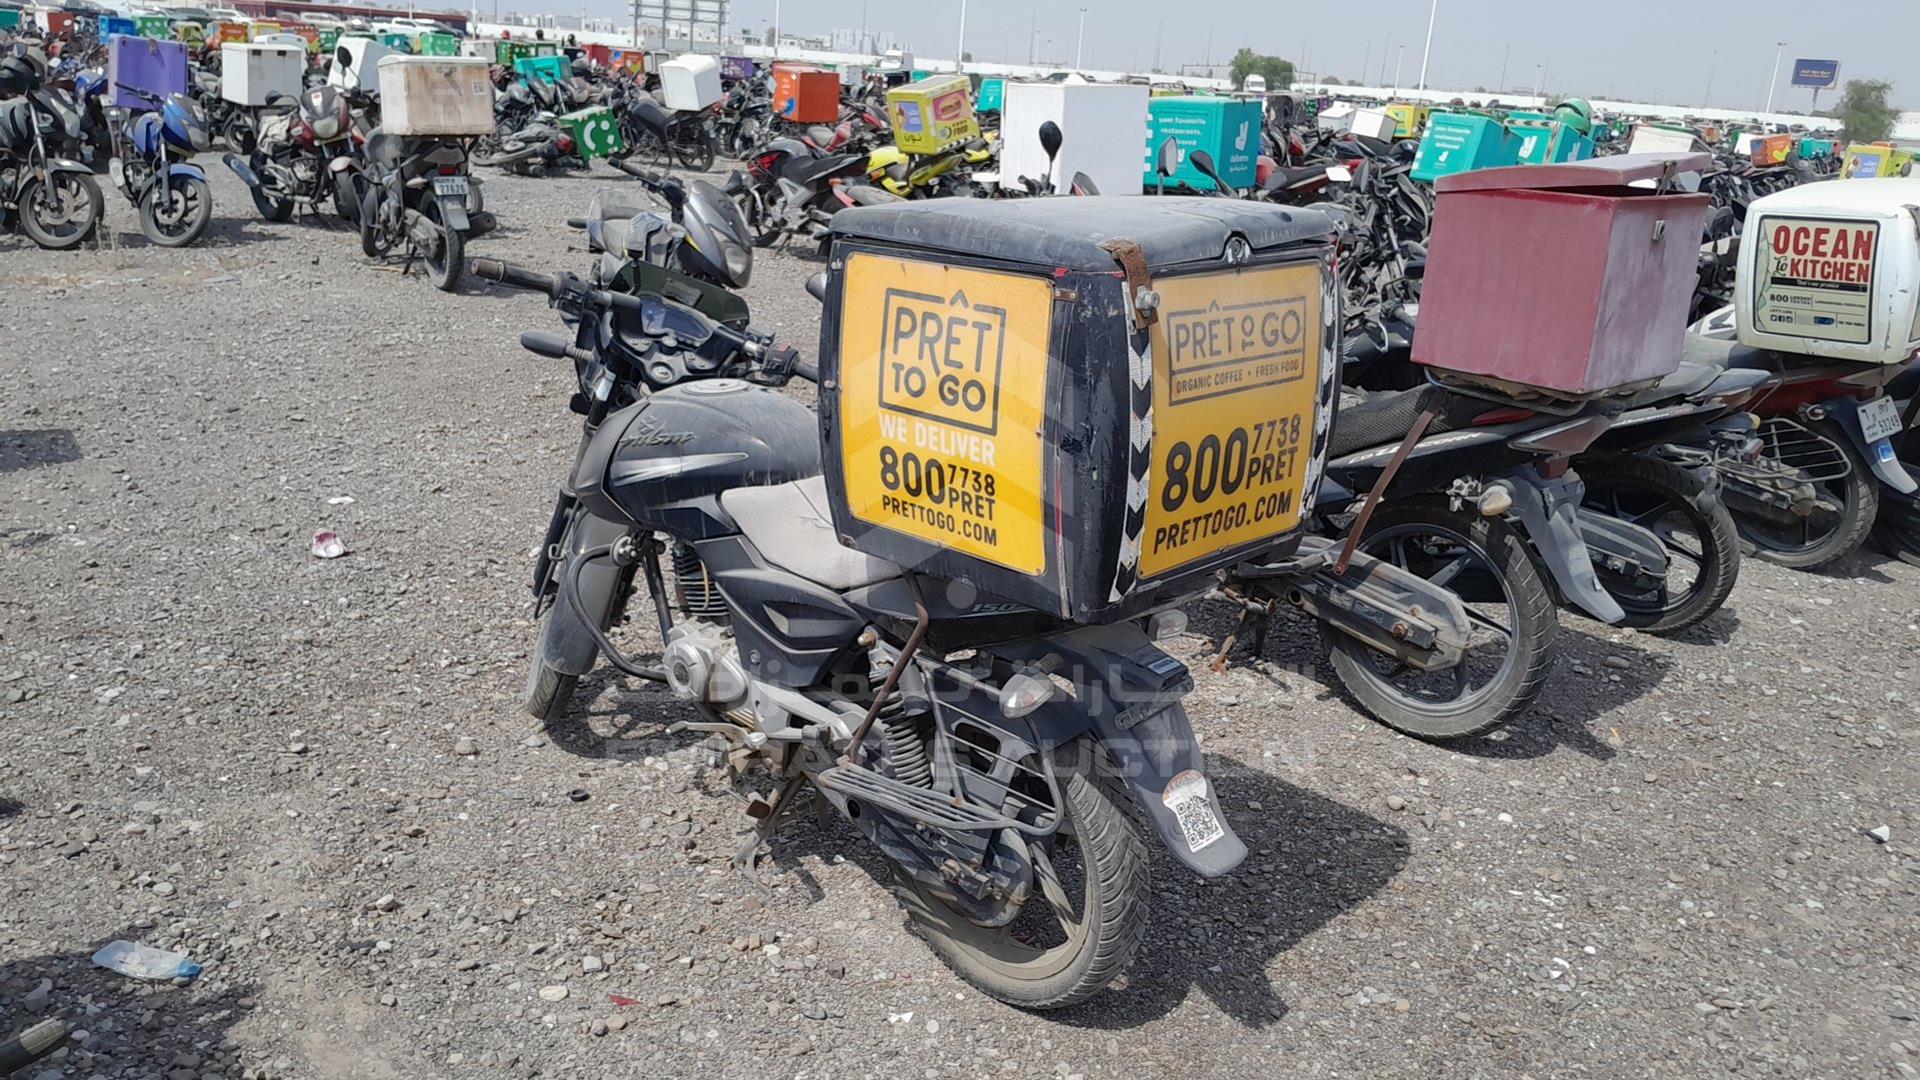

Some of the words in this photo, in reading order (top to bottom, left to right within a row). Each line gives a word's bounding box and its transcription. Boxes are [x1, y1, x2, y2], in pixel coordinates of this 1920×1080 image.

[1773, 225, 1873, 261] OCEAN
[1789, 258, 1870, 283] KITCHEN
[1769, 293, 1789, 303] 800
[1261, 309, 1300, 347] GO
[892, 362, 926, 398] TO
[939, 374, 986, 412] GO
[1176, 374, 1212, 394] ORGANIC
[1214, 370, 1243, 387] COFFEE
[1255, 363, 1280, 377] FRESH
[1281, 359, 1299, 373] FOOD
[879, 413, 907, 444] WE
[915, 422, 996, 466] DELIVER
[880, 445, 946, 505] 800
[948, 463, 996, 497] 7738
[1161, 427, 1249, 512] 800
[1252, 413, 1301, 455] 7738
[1245, 446, 1298, 490] PRET
[882, 494, 997, 547] PRETTOGO.COM
[949, 486, 996, 521] PRET
[1153, 489, 1293, 554] PRETTOGO.COM
[973, 602, 1019, 612] 150
